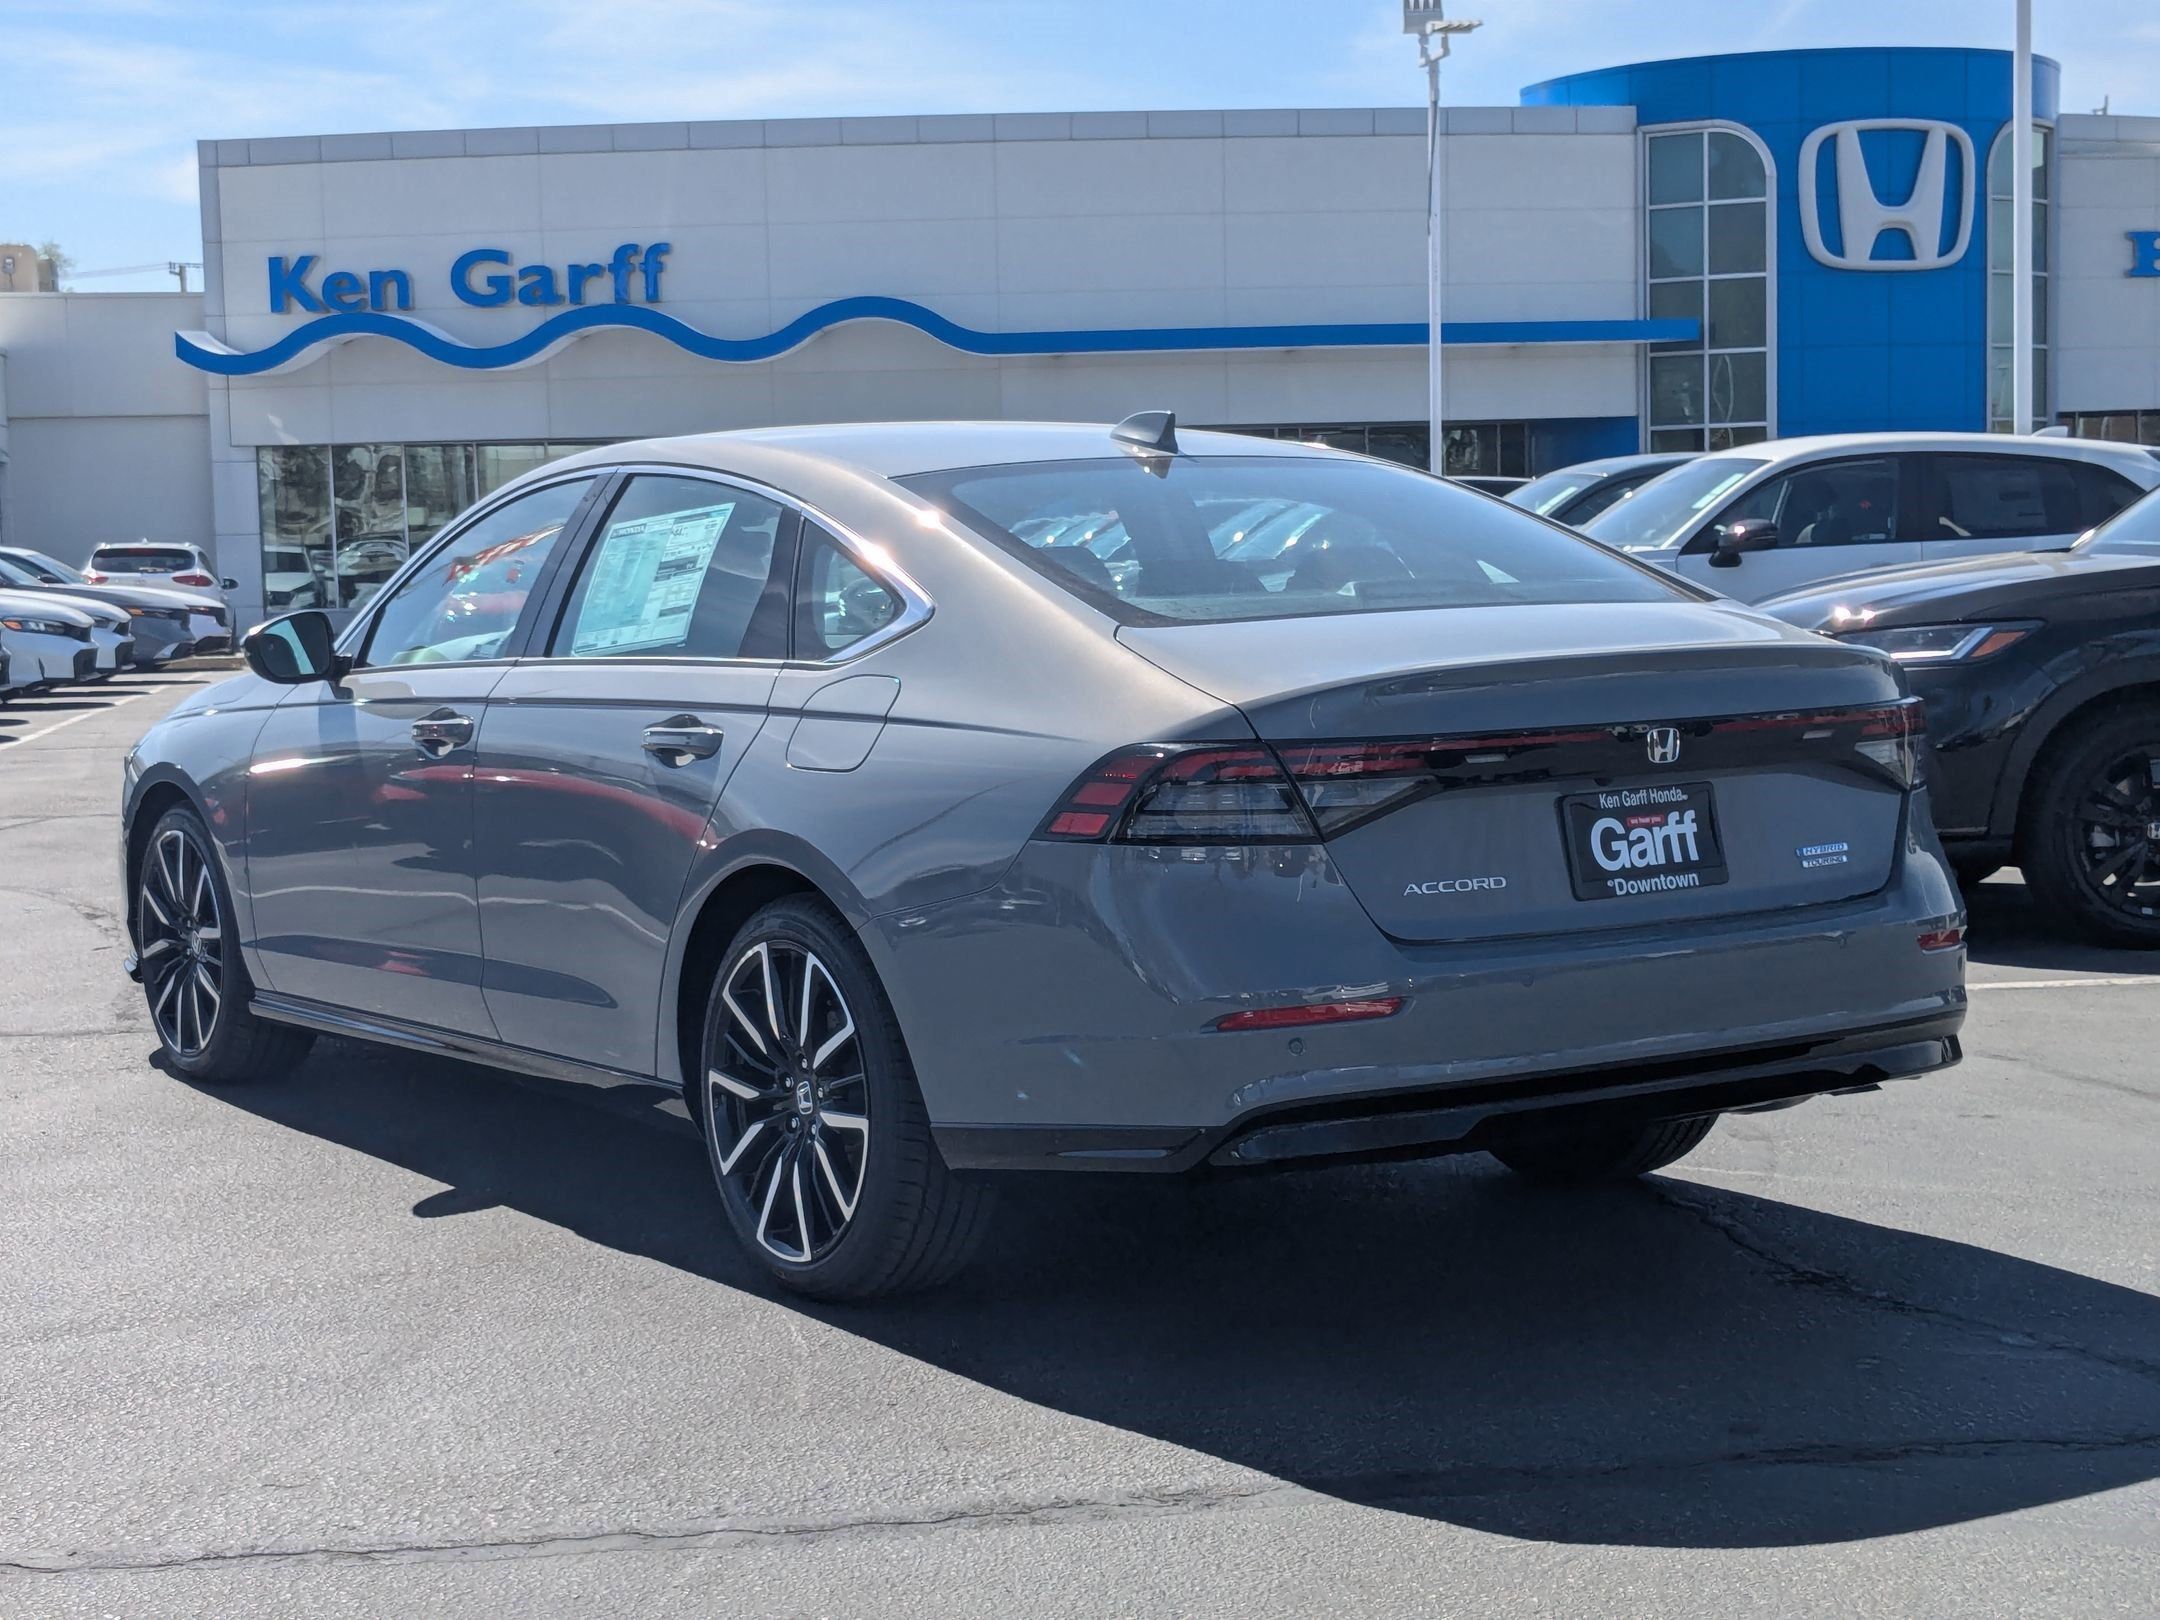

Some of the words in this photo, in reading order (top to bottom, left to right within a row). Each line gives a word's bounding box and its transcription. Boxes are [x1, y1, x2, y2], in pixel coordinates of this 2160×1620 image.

[267, 255, 412, 314] Ken
[450, 243, 671, 308] Garff
[1599, 793, 1620, 808] Ken
[1622, 789, 1648, 807] Garff
[1650, 786, 1683, 804] Honda
[1590, 809, 1700, 872] Garff
[1803, 843, 1845, 855] HYBRID
[1403, 876, 1507, 896] ACCORD
[1614, 872, 1700, 896] Downtown
